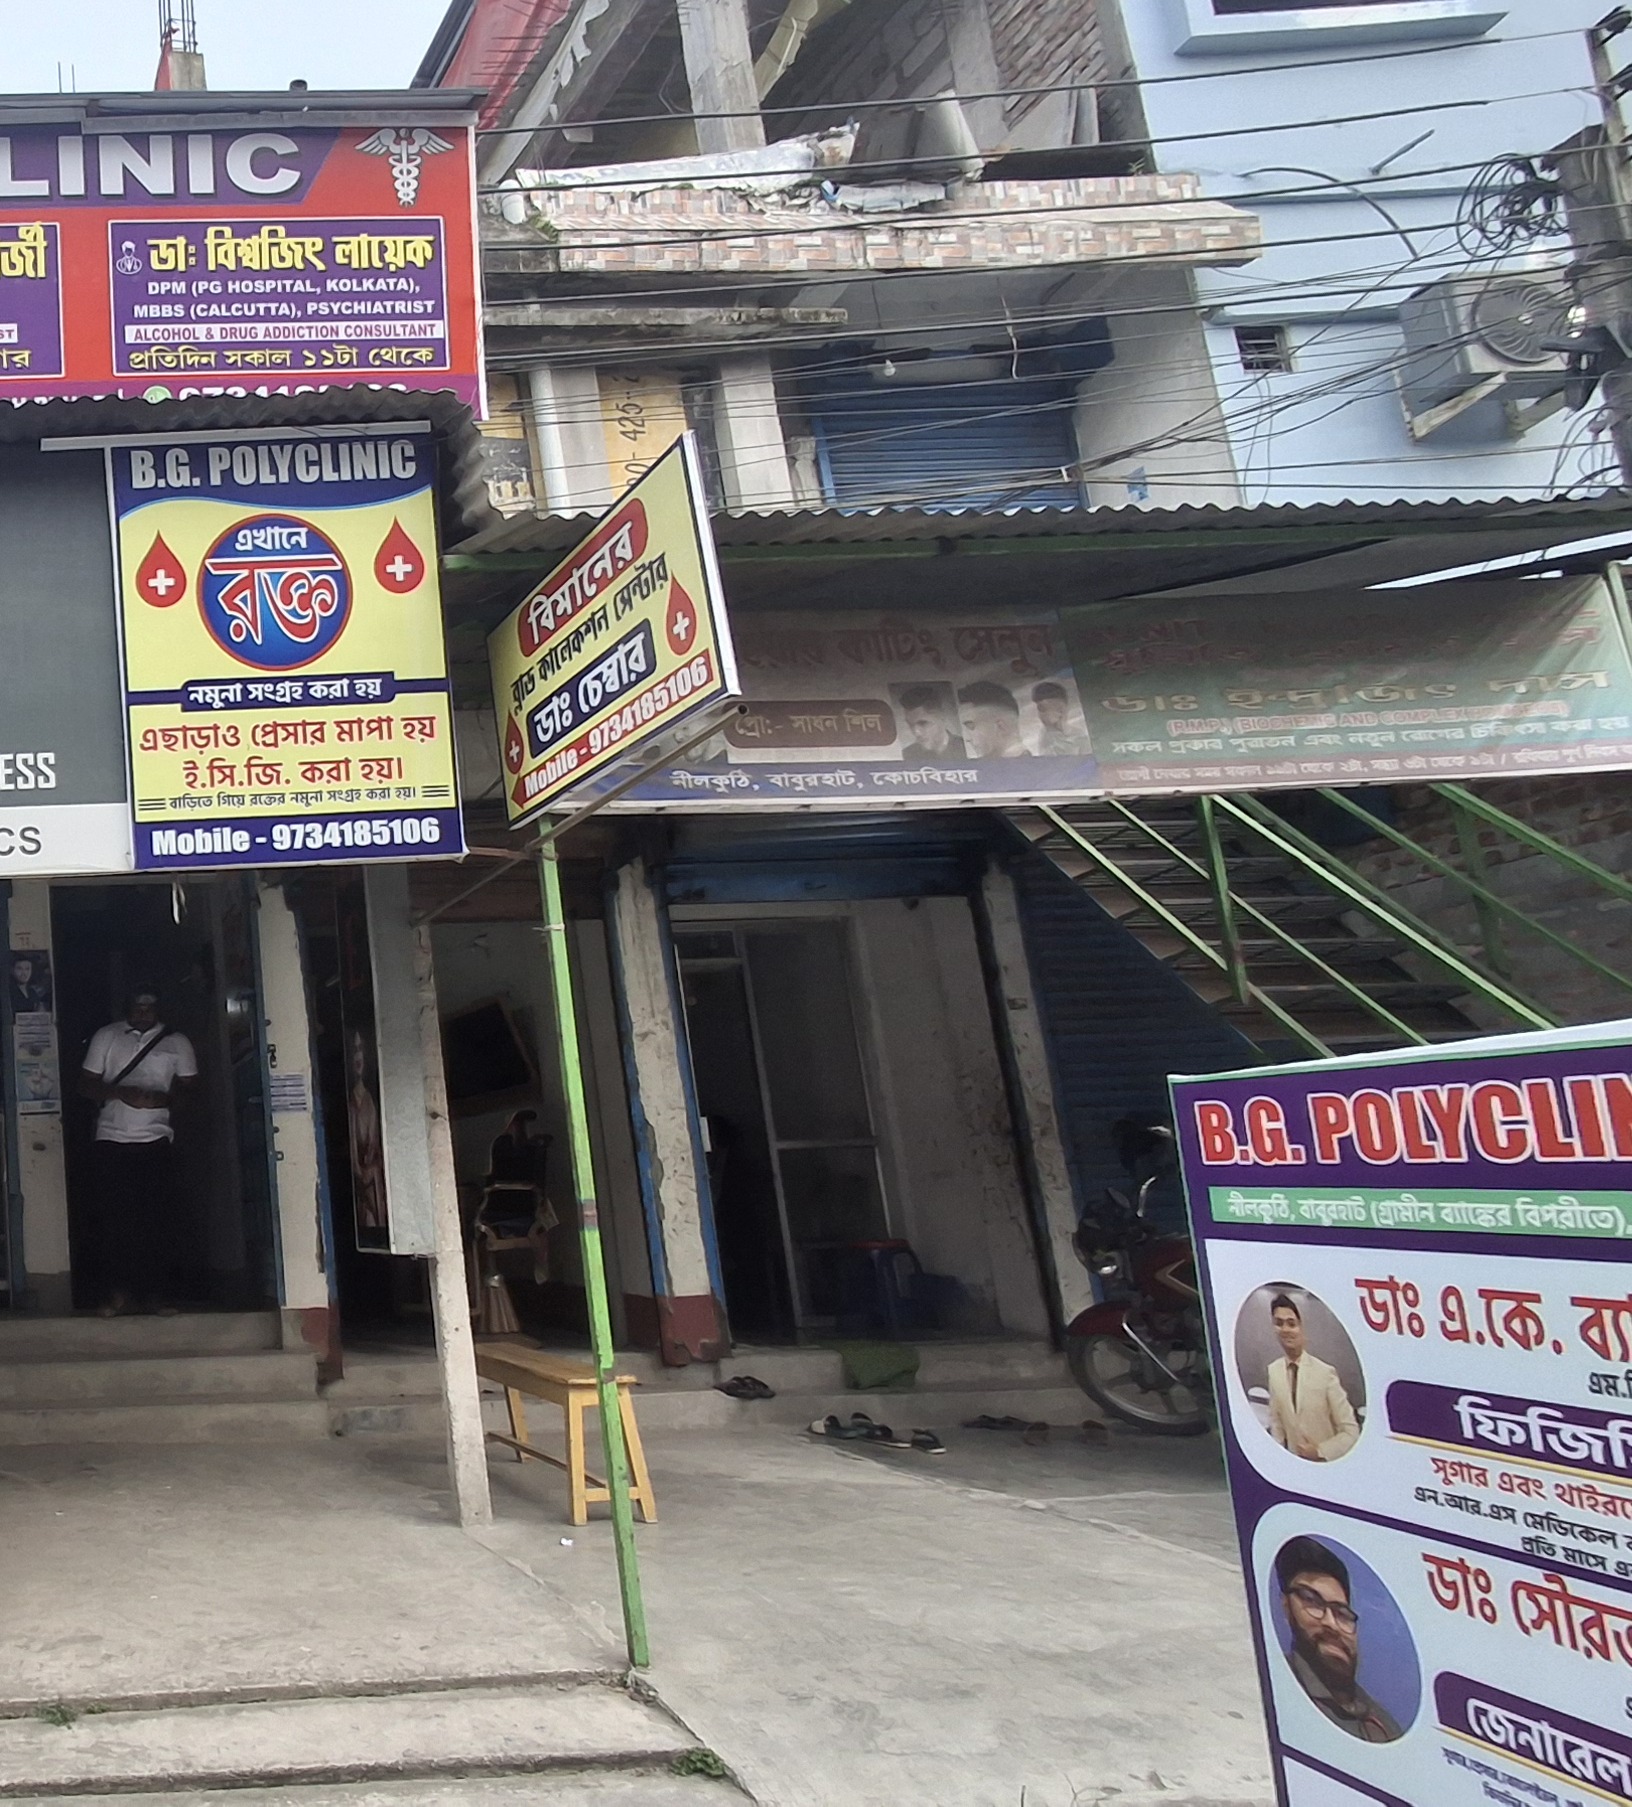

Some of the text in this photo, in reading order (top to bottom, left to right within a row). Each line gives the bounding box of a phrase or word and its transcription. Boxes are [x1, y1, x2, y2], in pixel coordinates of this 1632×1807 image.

[205, 226, 324, 273] বিশ্বজিৎ
[147, 277, 420, 298] DPM (PG HOSPITAL, KOLKATA),
[133, 300, 435, 319] MBBS (CALCUTTA), PSYCHIATRIST
[133, 323, 436, 342] ALCOHOL & DRUG ADDICTION CONSULTANT
[128, 344, 435, 372] প্রতিদিন সকাল ১১টা থেকে
[131, 440, 417, 489] B.G. POLYCLINIC
[235, 526, 309, 551] এখানে
[205, 554, 343, 645] রক্ত
[527, 521, 634, 646] বিমানের
[538, 610, 609, 677] কালেকশন
[613, 552, 670, 623] সেন্টার
[188, 678, 382, 709] নমুনা সংগ্রহ করা হয়
[532, 631, 647, 745] ডাঃ চেম্বার
[139, 716, 436, 755] এছাড়াও প্রেসার মাপা হয়
[522, 745, 579, 800] Mobile
[587, 656, 709, 756] 9734185106
[1112, 740, 1163, 754] সকল
[1304, 734, 1344, 747] এবং
[183, 756, 291, 789] ই.সি.জি.
[298, 757, 351, 784] করা
[670, 765, 980, 794] নীলকুঠি, বাবুরহাট, কোচবিহার
[290, 790, 323, 807] নমুনা
[328, 789, 362, 803] সংগ্রহ
[367, 788, 391, 800] করা
[152, 827, 250, 857] Mobile
[272, 817, 440, 850] 9734185106
[1194, 1095, 1306, 1166] B.G.
[1298, 1196, 1366, 1227] বাবুরহাট
[1354, 1273, 1565, 1358] ডাঃ এ.কে.
[1430, 1456, 1548, 1500] সুগার এবং
[1522, 1510, 1619, 1550] মেডিকেল
[1520, 1536, 1608, 1572] প্রতি মাসে
[1421, 1551, 1497, 1626] ডাঃ
